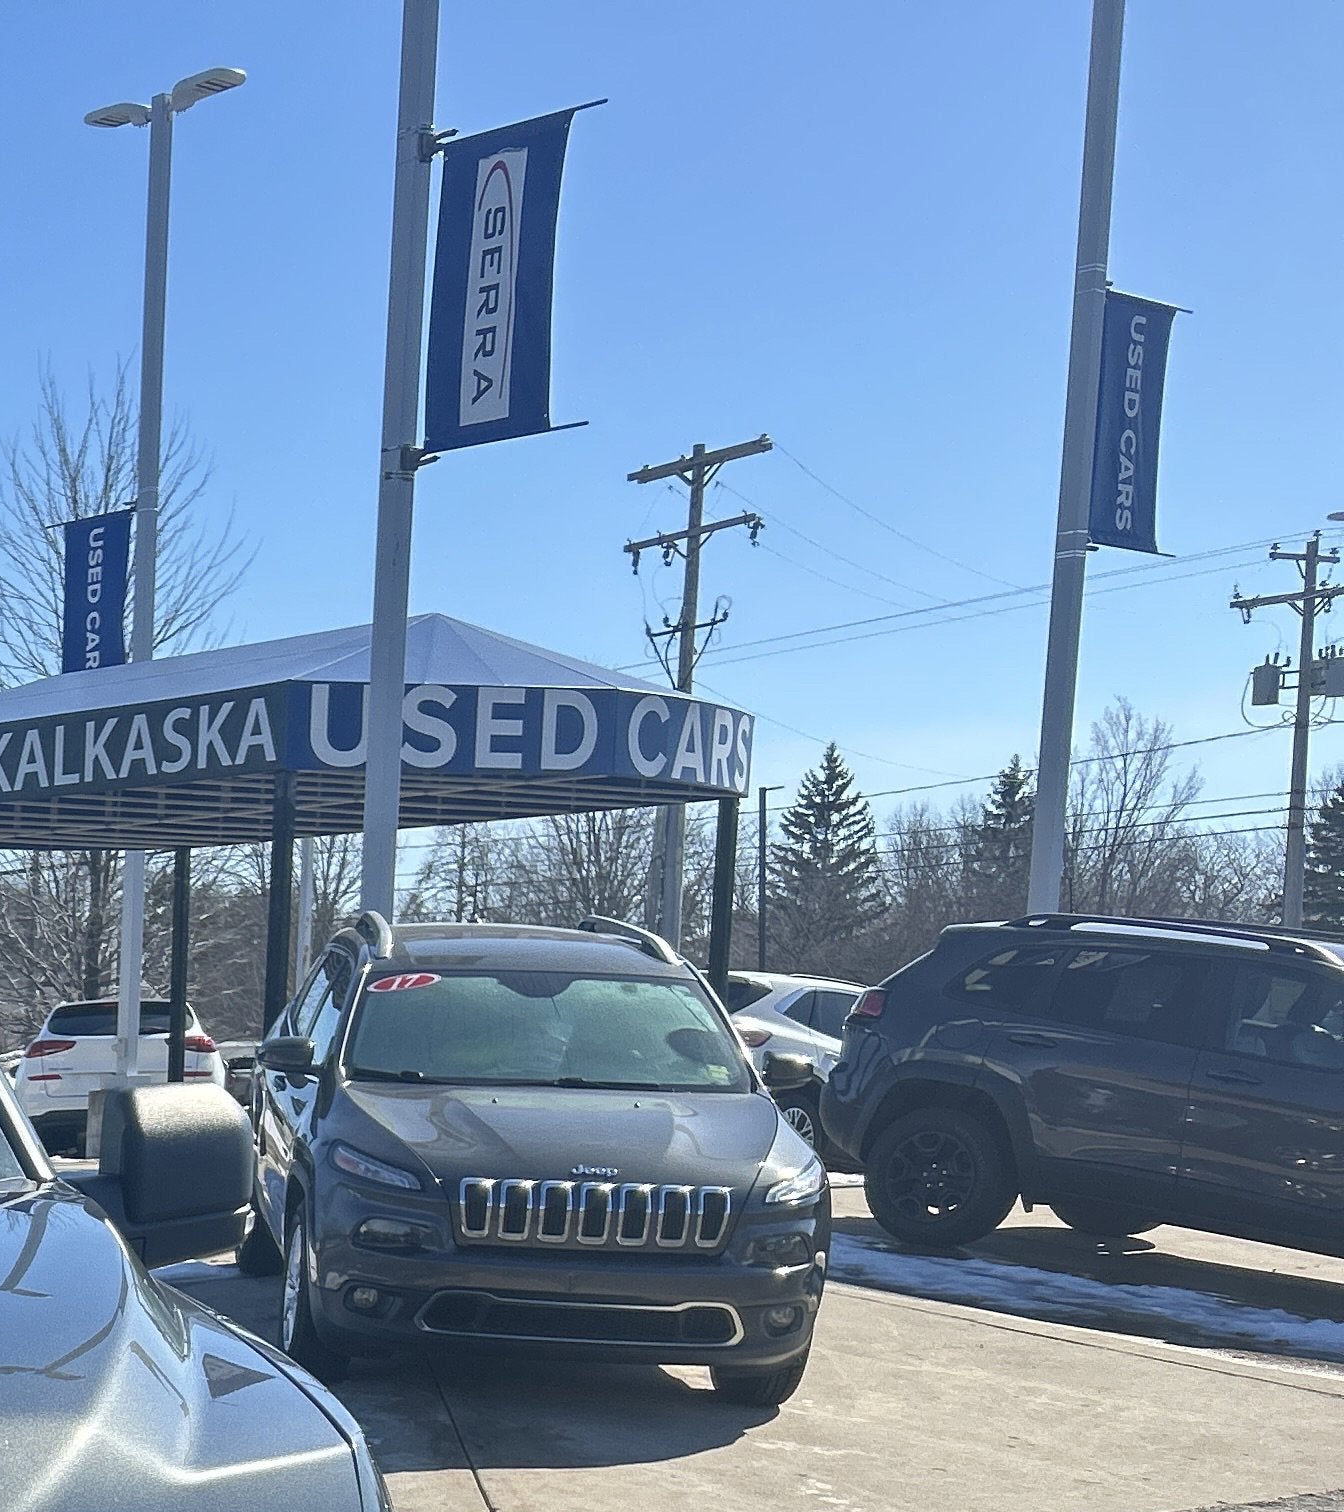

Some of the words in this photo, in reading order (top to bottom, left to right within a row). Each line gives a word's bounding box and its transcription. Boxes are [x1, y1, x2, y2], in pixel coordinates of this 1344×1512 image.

[471, 205, 506, 406] SERRA
[1123, 314, 1146, 418] USED
[1115, 429, 1137, 532] CARS
[87, 527, 105, 604] USED
[85, 611, 101, 669] CAR
[309, 683, 599, 771] USED
[627, 695, 750, 794] CARS
